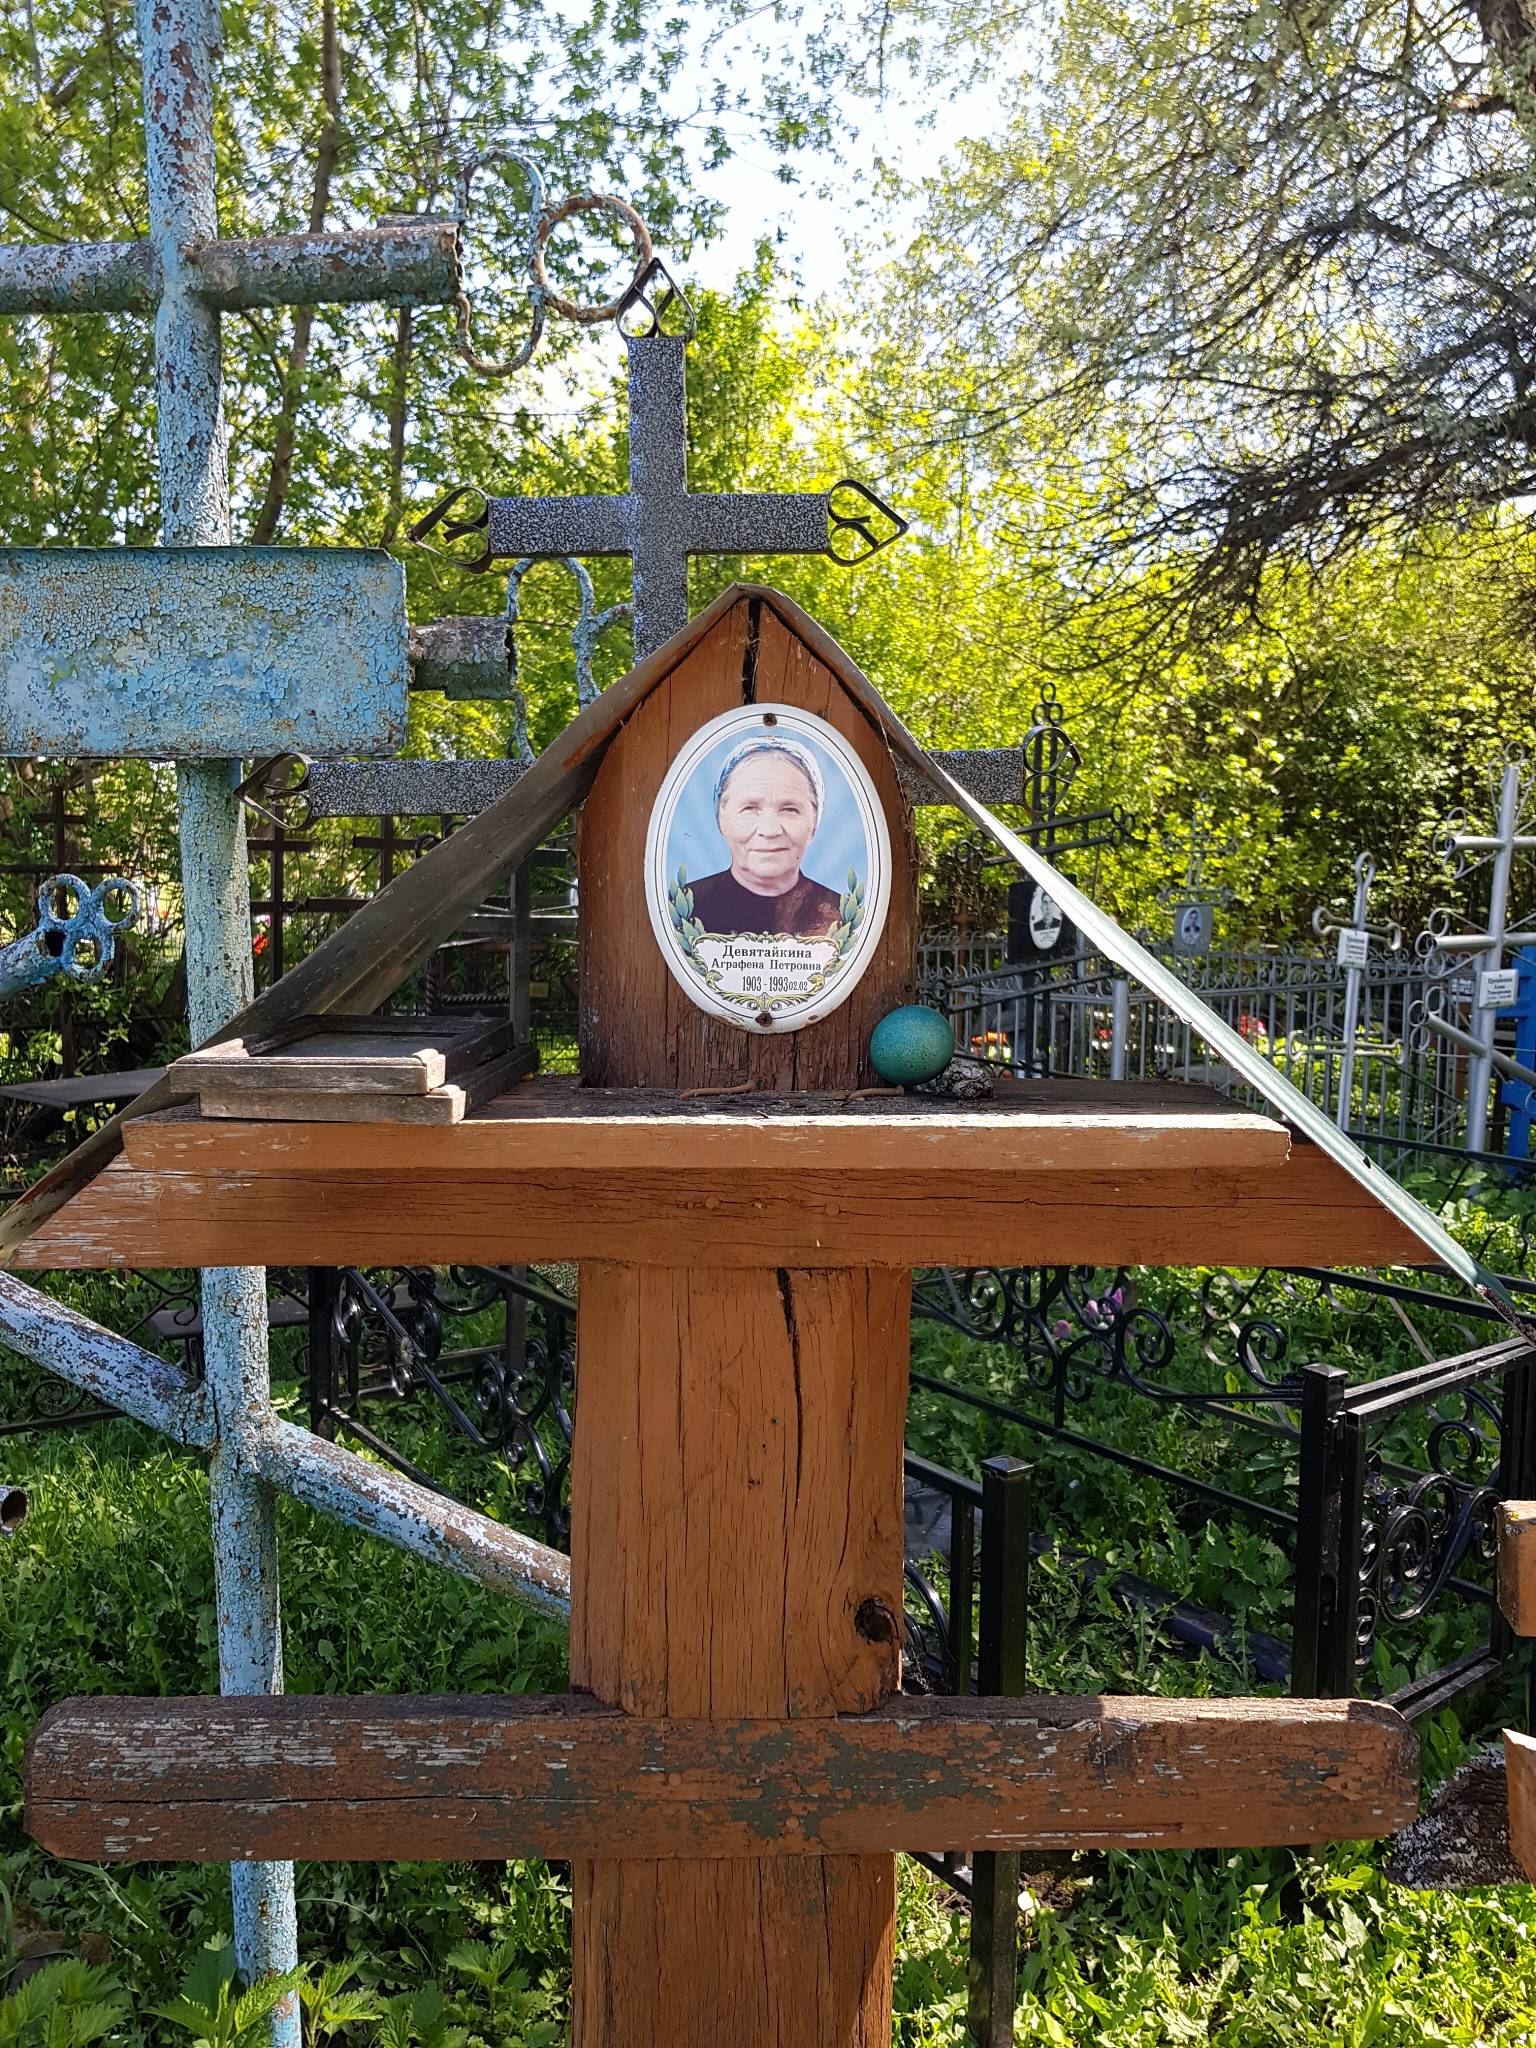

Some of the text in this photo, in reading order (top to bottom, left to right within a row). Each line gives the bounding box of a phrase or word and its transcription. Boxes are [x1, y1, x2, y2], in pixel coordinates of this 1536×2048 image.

[722, 945, 812, 959] Девятайкина
[711, 958, 821, 972] Аграфена Петровна
